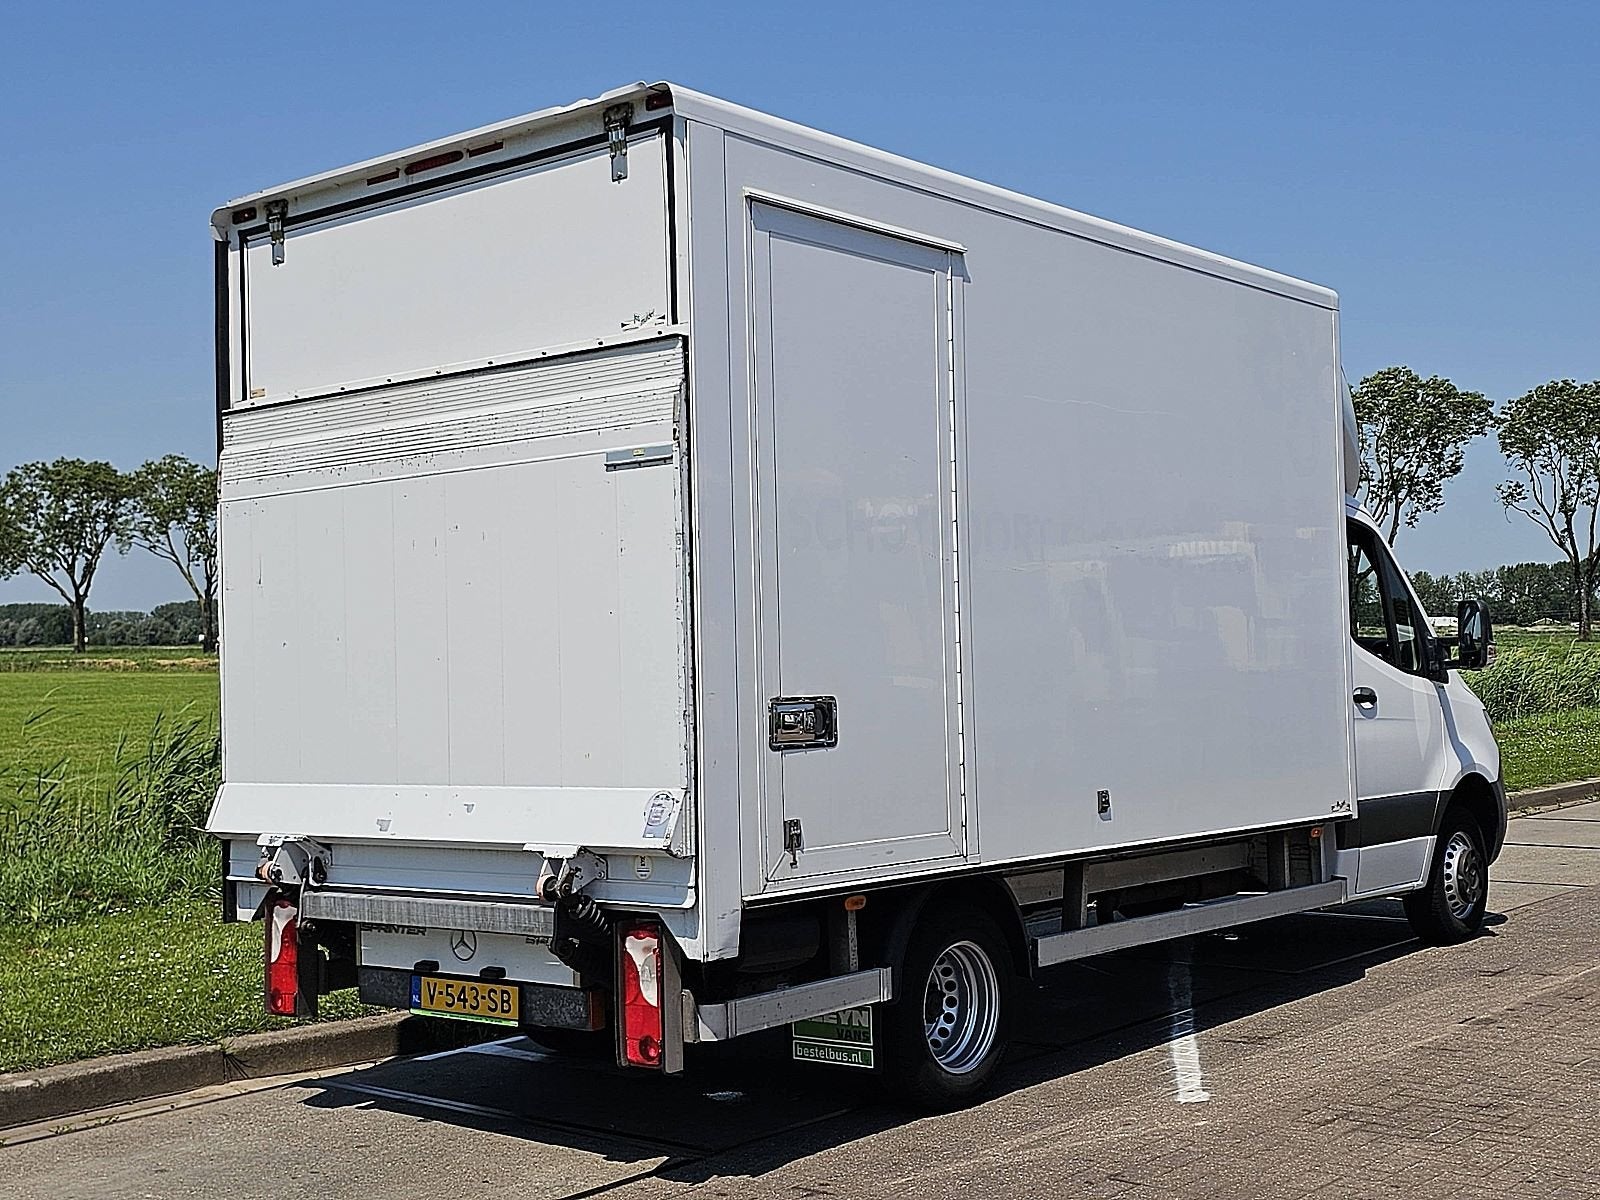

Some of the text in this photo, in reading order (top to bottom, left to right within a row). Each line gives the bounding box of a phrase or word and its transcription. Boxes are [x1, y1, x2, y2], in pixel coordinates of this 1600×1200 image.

[412, 994, 421, 1003] NL
[426, 981, 512, 1014] V-543-SB
[836, 1027, 870, 1041] VANS
[796, 1044, 863, 1063] bestelbus.nl
